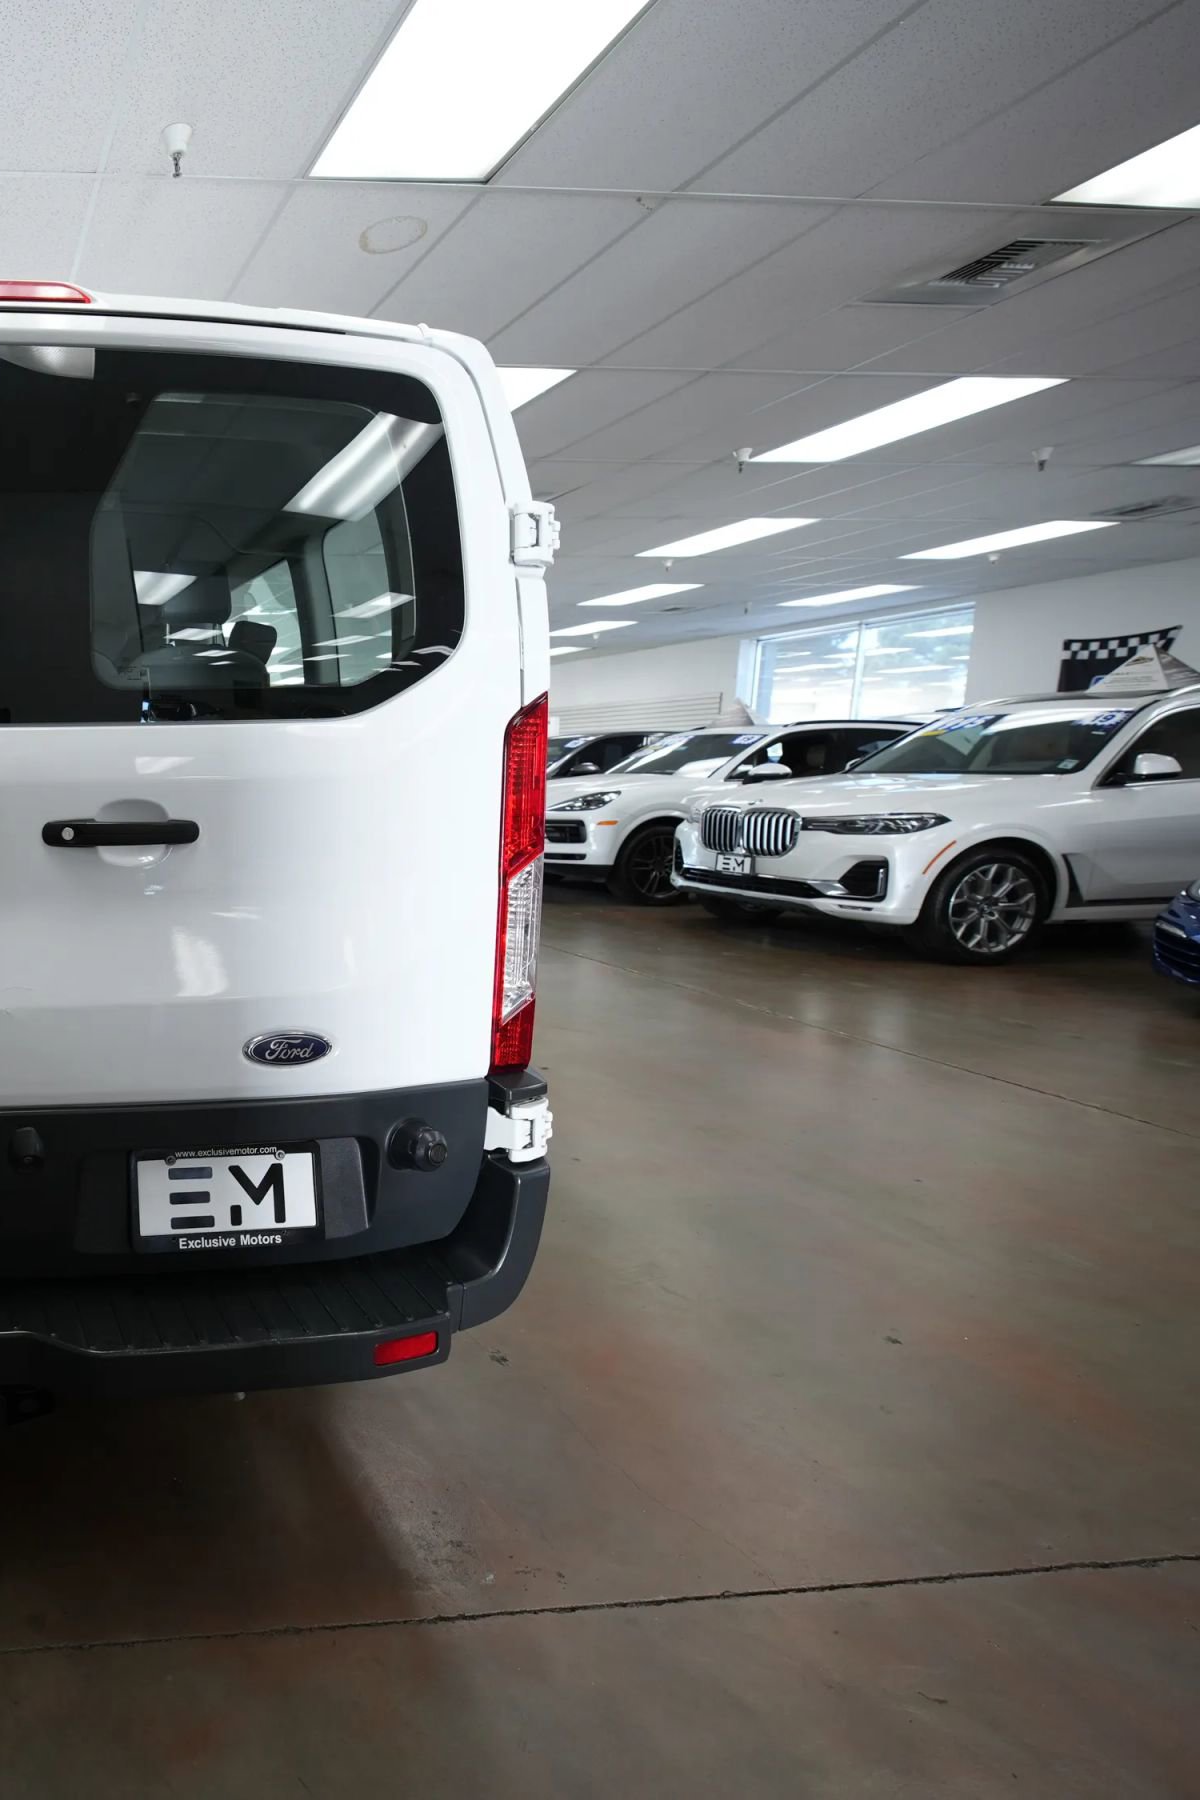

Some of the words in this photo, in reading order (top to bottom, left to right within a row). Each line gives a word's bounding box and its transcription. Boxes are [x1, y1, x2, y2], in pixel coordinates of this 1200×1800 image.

[265, 1039, 314, 1060] Ford
[175, 1146, 278, 1158] www.exclusivemotor.com
[179, 1236, 236, 1249] Exclusive
[240, 1234, 282, 1246] Motors
